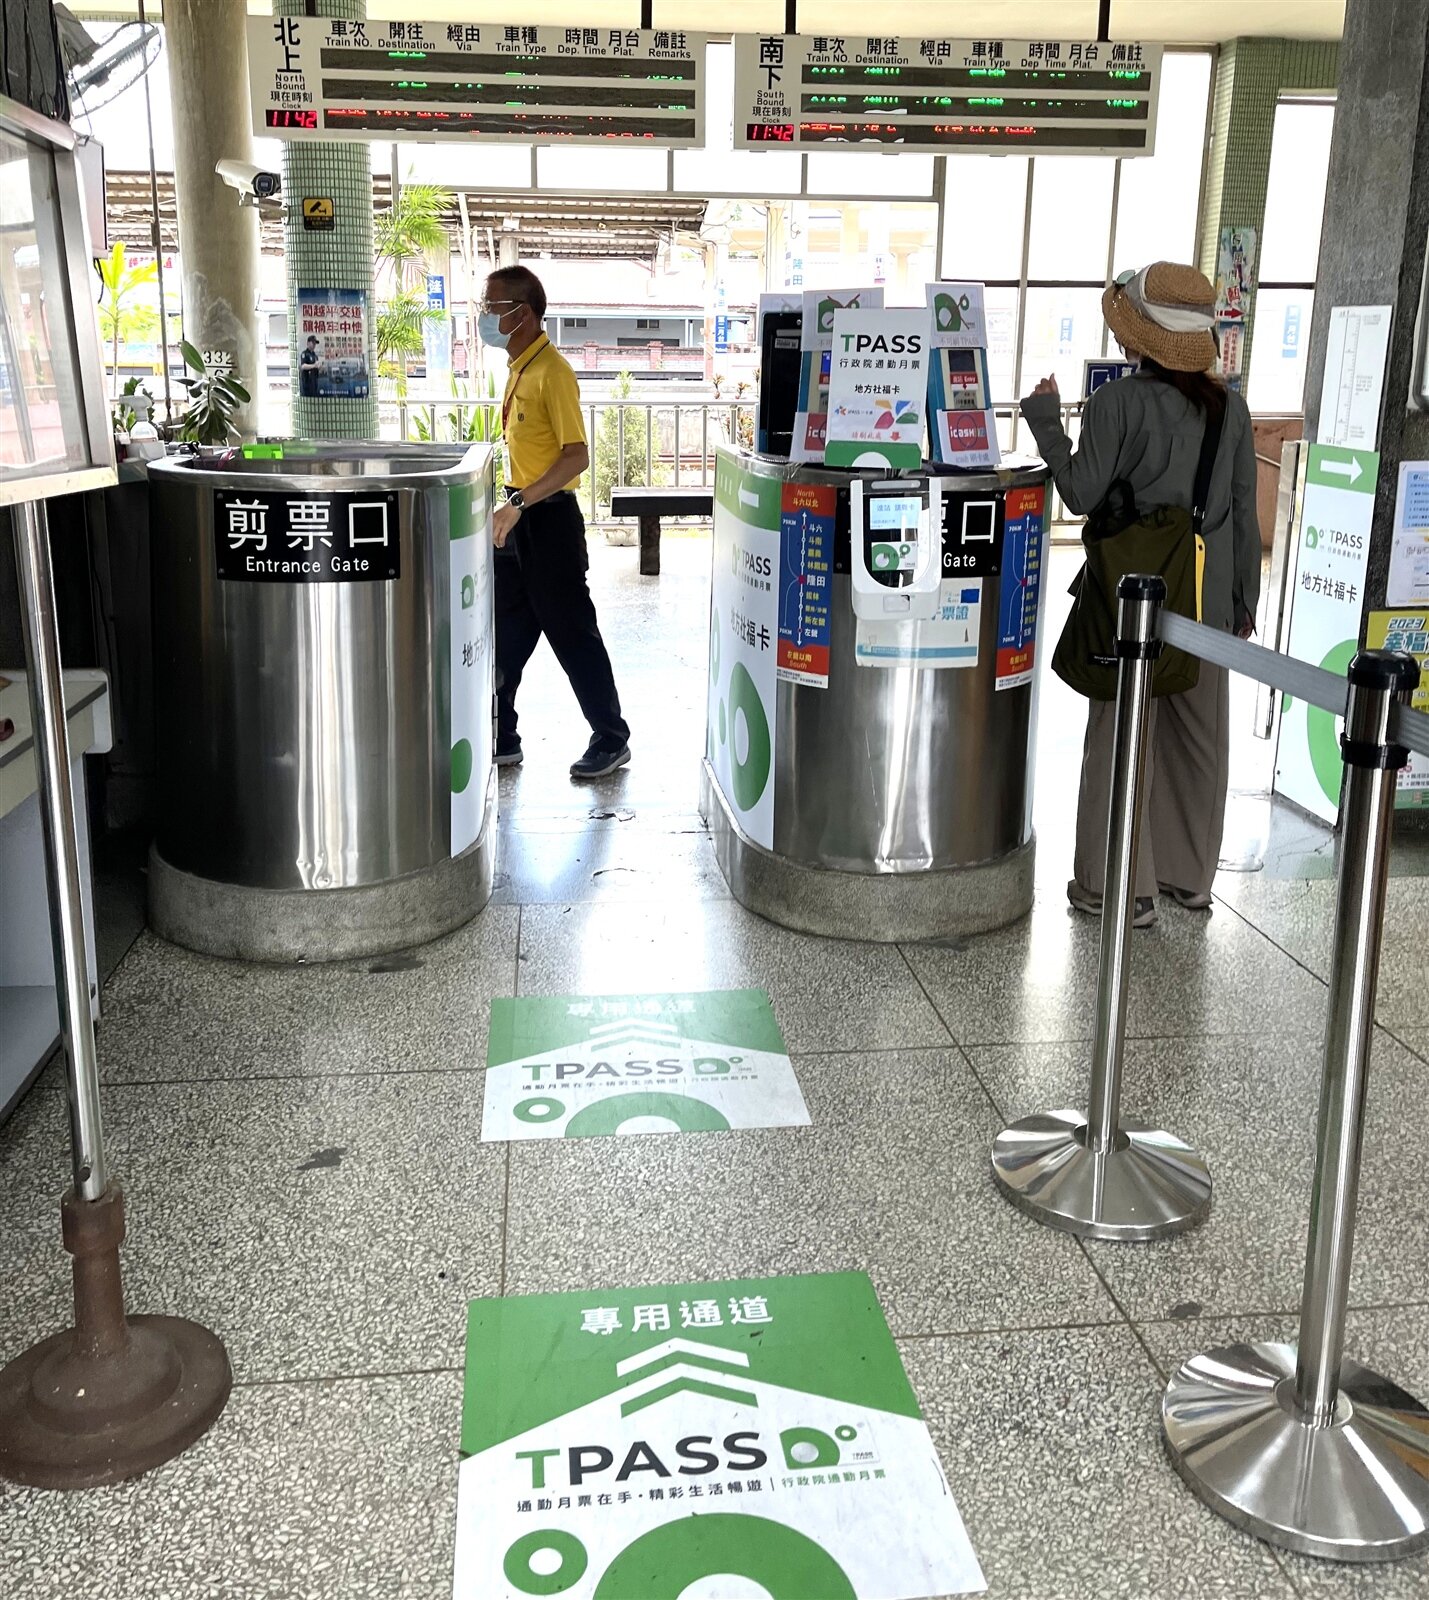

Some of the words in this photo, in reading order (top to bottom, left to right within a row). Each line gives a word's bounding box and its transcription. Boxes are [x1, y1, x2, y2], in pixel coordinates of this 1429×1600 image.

[331, 20, 366, 38] 車次
[389, 22, 423, 40] 開往
[447, 24, 480, 42] 經由
[504, 26, 538, 43] 車種
[565, 28, 598, 46] 時間
[608, 30, 640, 48] 月台
[654, 32, 687, 49] 備註
[273, 17, 302, 73] 北上
[325, 37, 350, 48] Train
[353, 38, 372, 48] NO.
[378, 39, 436, 50] Destination
[457, 41, 472, 51] Via
[495, 42, 520, 52] Train
[523, 43, 547, 54] Type
[558, 45, 580, 55] Dep.
[584, 46, 607, 56] Time
[613, 47, 635, 57] Plat.
[648, 48, 691, 59] Remarks
[813, 37, 845, 55] 車次
[866, 38, 898, 56] 開往
[920, 39, 951, 57] 經由
[972, 41, 1003, 58] 車種
[1029, 42, 1060, 59] 時間
[1069, 43, 1098, 60] 月台
[1112, 44, 1142, 61] 備註
[759, 36, 784, 90] 南下
[806, 53, 830, 63] Train
[833, 54, 850, 63] NO.
[855, 55, 909, 65] Destination
[928, 57, 943, 66] Via
[963, 57, 987, 67] Train
[989, 58, 1011, 68] Type
[1045, 59, 1067, 68] Time
[1072, 60, 1092, 69] Plat.
[1106, 60, 1146, 70] Remarks
[275, 74, 305, 82] North
[275, 82, 306, 91] Bound
[270, 91, 313, 103] 現在時刻
[757, 90, 785, 99] South
[757, 98, 784, 107] Bound
[752, 106, 792, 117] 現在時刻
[752, 125, 794, 141] 11:42
[840, 334, 922, 354] TPASS
[839, 358, 920, 370] 行政院通勤月票
[854, 384, 901, 395] 地方社福卡
[796, 489, 815, 498] North
[225, 498, 389, 551] 剪票口
[808, 523, 823, 533] 斗六
[1329, 529, 1363, 549] TPASS
[246, 556, 321, 573] Entrance
[331, 555, 370, 573] Gate
[741, 547, 772, 577] TPASS
[943, 552, 976, 568] Gate
[806, 574, 826, 587] 隆田
[1301, 570, 1358, 604] 地方社福卡
[730, 606, 771, 652] 地方社福卡
[1387, 617, 1426, 630] 2023
[804, 628, 818, 638] 左營
[521, 1058, 684, 1081] TPASS
[579, 1295, 774, 1336] 專用通道
[515, 1431, 768, 1489] TPASS
[781, 1468, 887, 1490] 行政院通勤月票
